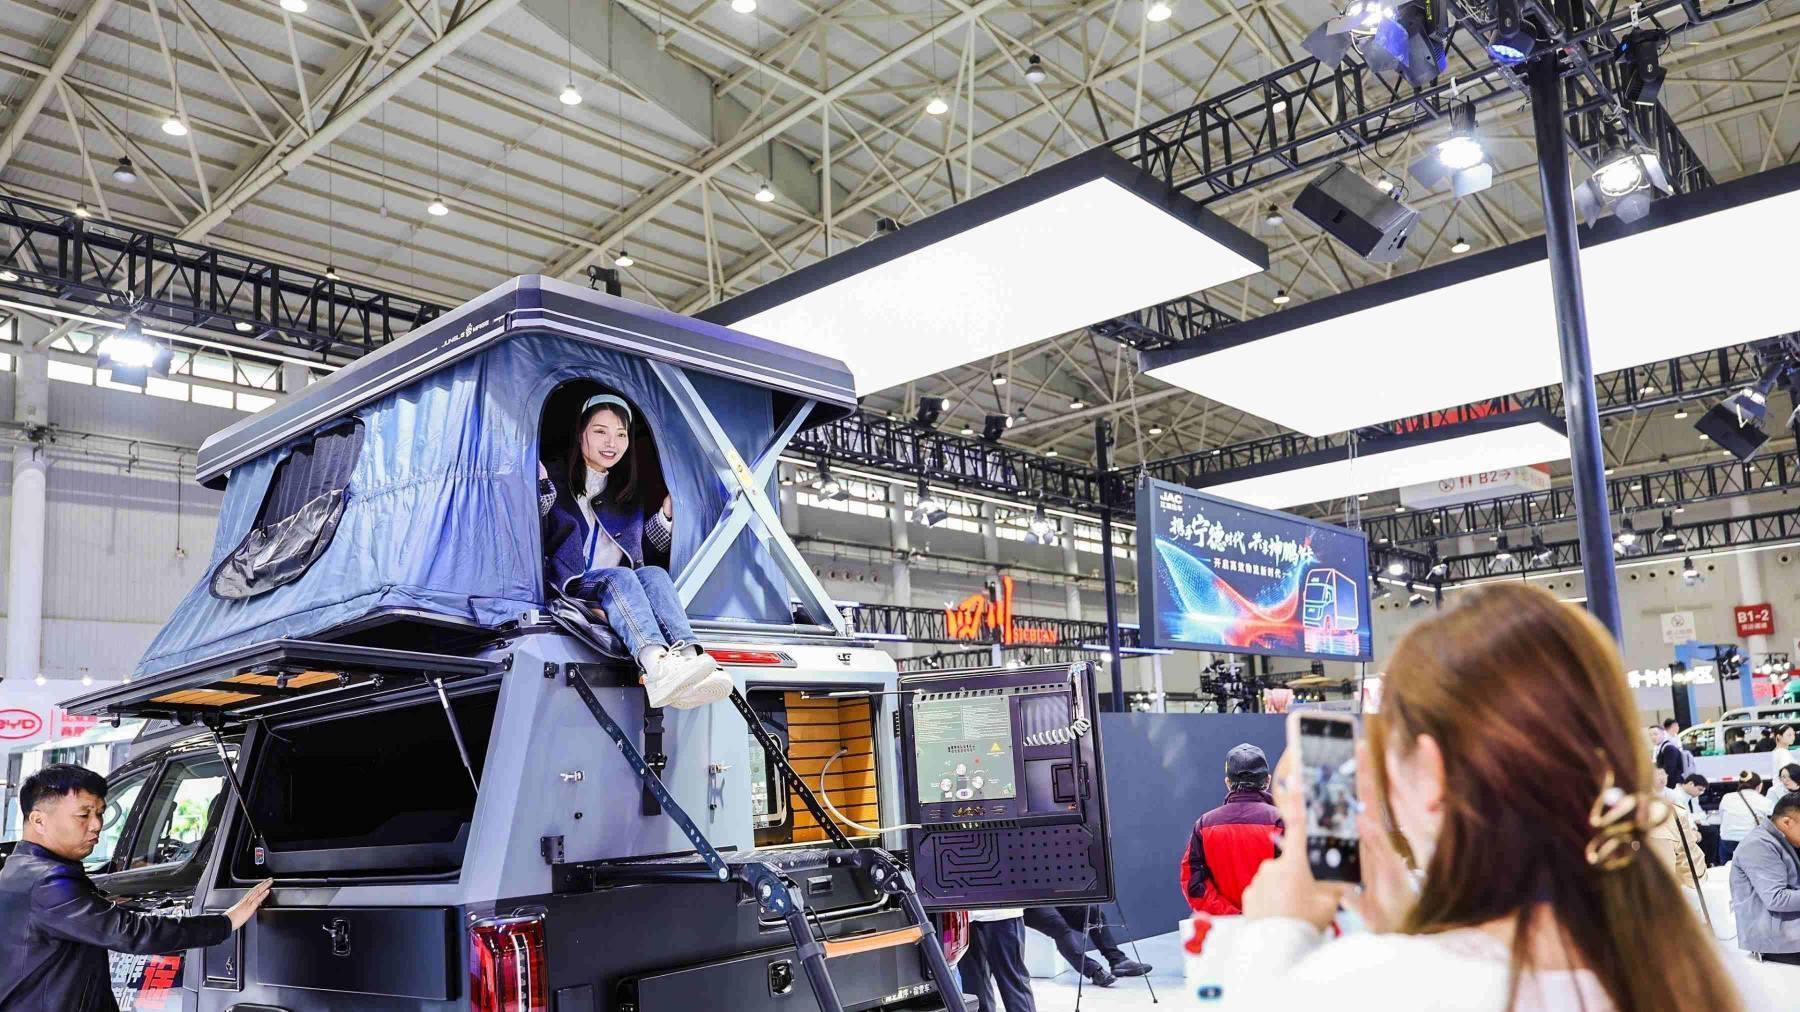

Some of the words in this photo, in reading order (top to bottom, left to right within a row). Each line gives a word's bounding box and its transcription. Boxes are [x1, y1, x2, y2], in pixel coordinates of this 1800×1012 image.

[1479, 471, 1498, 485] B2
[1159, 491, 1183, 505] JAC
[1213, 557, 1281, 579] 开启高效物流新时代
[1737, 609, 1769, 623] B1-2
[1014, 627, 1058, 645] SICHUAN
